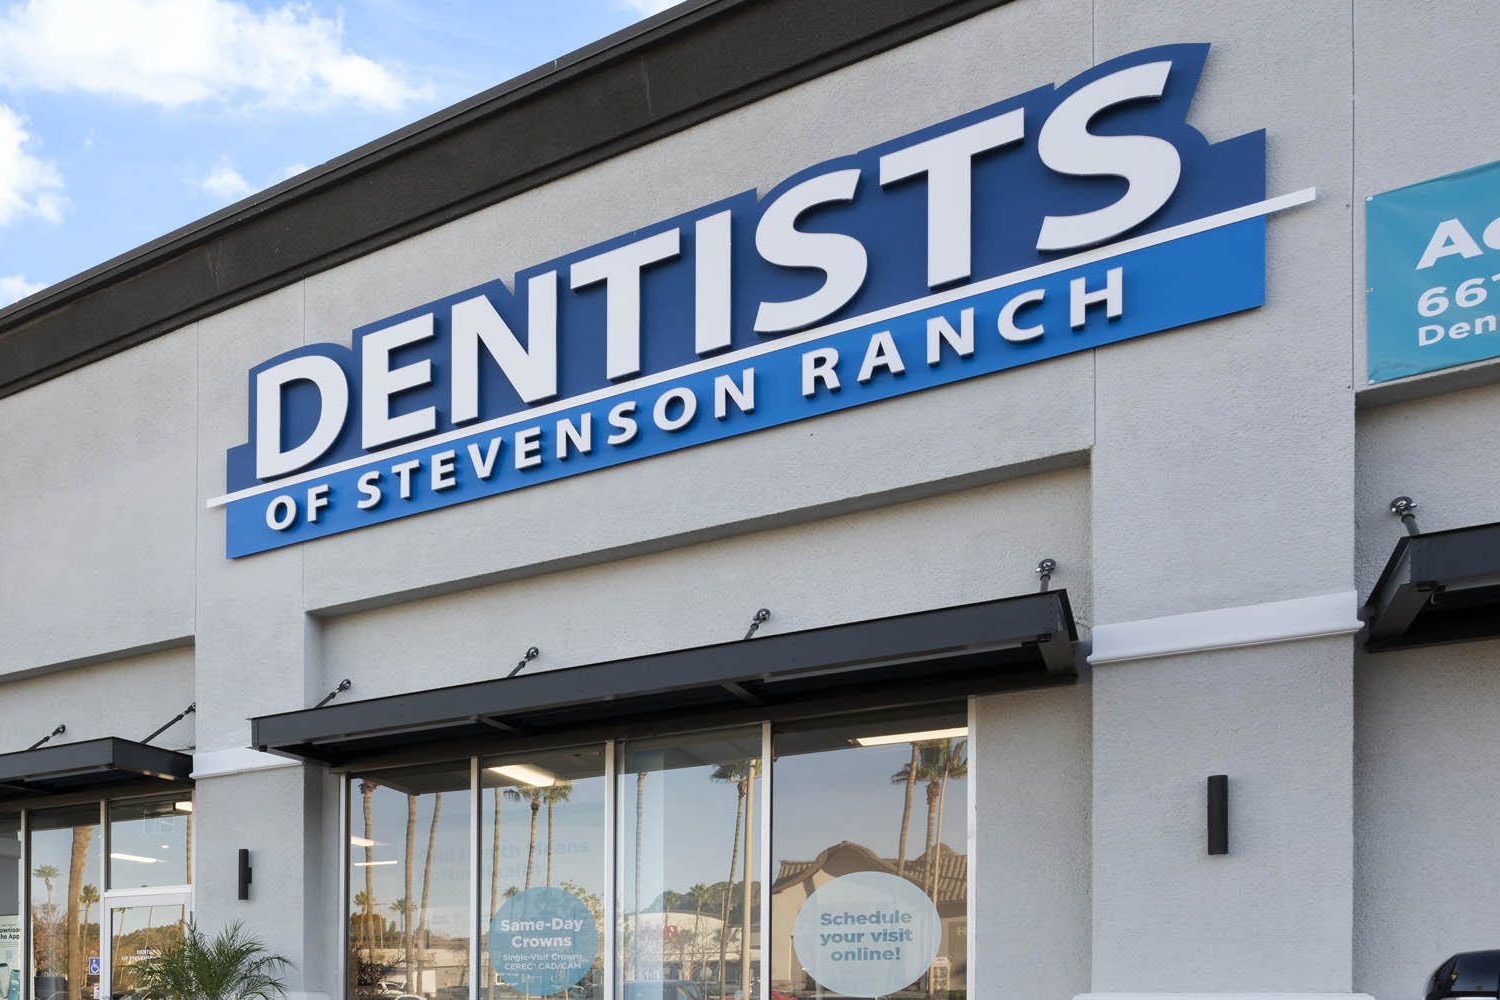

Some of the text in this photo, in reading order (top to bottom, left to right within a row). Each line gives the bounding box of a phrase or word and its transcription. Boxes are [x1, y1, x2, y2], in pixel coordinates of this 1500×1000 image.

[257, 61, 1181, 478] DENTISTS
[266, 266, 1123, 530] OF STEVENSON RANCH
[501, 918, 584, 933] Same-Day
[820, 910, 913, 926] Schedule
[512, 935, 572, 948] Crowns
[820, 926, 913, 947] your visit
[503, 953, 583, 962] Single-Visit Crowns
[830, 947, 901, 961] online!
[538, 962, 582, 970] CAD/CAM
